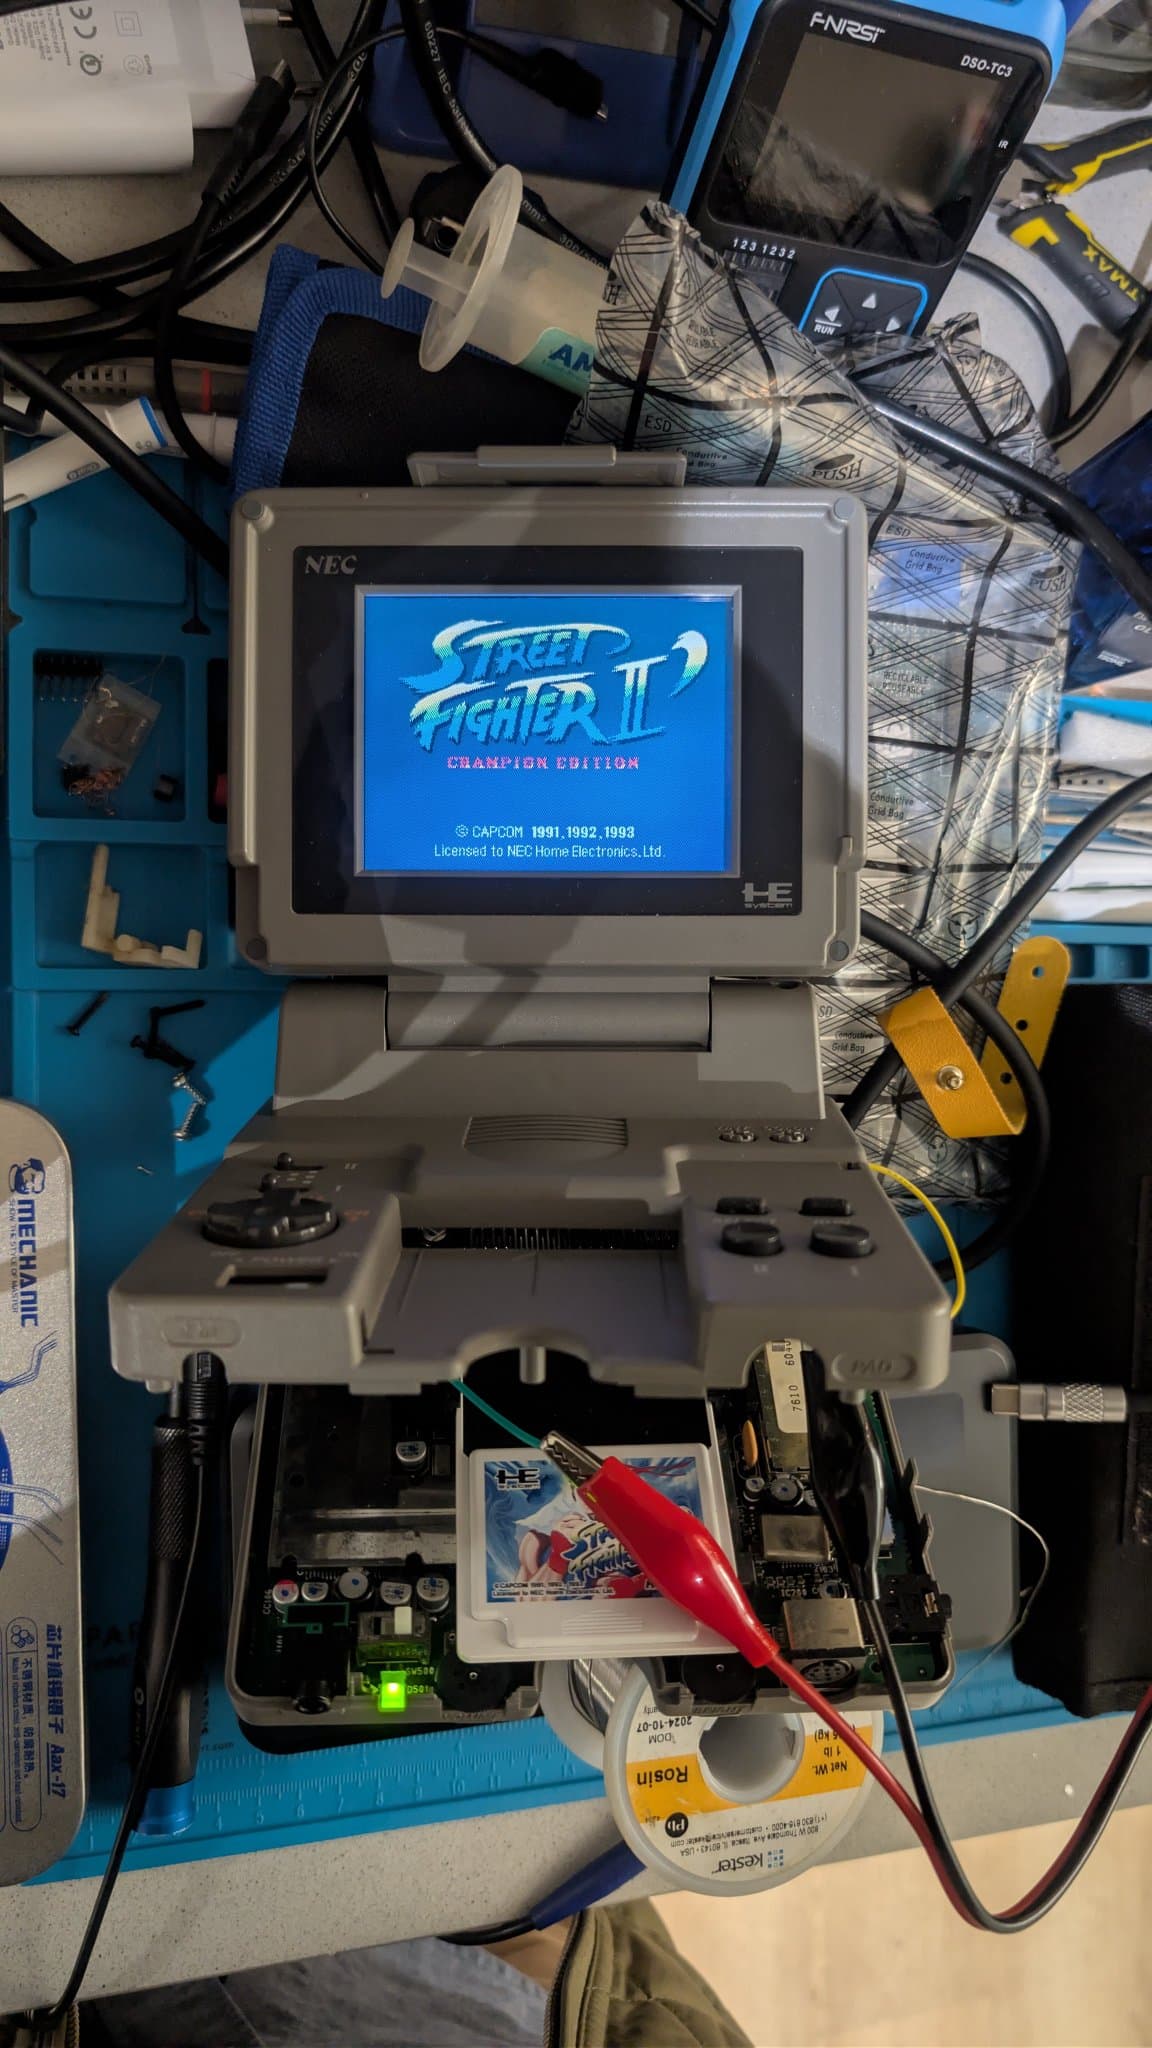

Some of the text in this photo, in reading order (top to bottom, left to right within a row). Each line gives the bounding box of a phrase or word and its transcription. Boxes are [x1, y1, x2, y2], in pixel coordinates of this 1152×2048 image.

[424, 20, 441, 63] 60227
[437, 68, 452, 95] IEC
[960, 55, 1013, 78] DSO-TC3
[998, 139, 1009, 150] IR
[813, 324, 836, 336] RUN
[644, 415, 672, 433] ESD
[810, 458, 864, 482] PUSH
[885, 524, 912, 538] ESD
[305, 555, 358, 575] NEC
[1029, 572, 1068, 593] PUSH
[400, 619, 632, 694] STREET
[409, 672, 610, 751] FIGHTER
[447, 756, 640, 769] CHAMPION EDITION
[472, 825, 524, 839] CAPCOM
[434, 844, 488, 858] Licensed
[491, 845, 504, 858] to
[507, 845, 534, 858] NEC
[535, 845, 570, 858] Home
[817, 1005, 833, 1018] SD
[18, 1199, 38, 1328] MECHANIC
[788, 1384, 804, 1412] 7610
[636, 1715, 692, 1733] 2024-10-07
[648, 1732, 672, 1744] DOM
[835, 1746, 841, 1757] 1
[811, 1760, 848, 1775] Net Wt.
[636, 1765, 689, 1788] Rosin
[801, 1815, 814, 1827] 630
[767, 1827, 797, 1843] Thorndale
[798, 1827, 806, 1836] W
[679, 1846, 695, 1857] USA
[700, 1841, 721, 1853] 60143
[714, 1852, 764, 1874] kester
